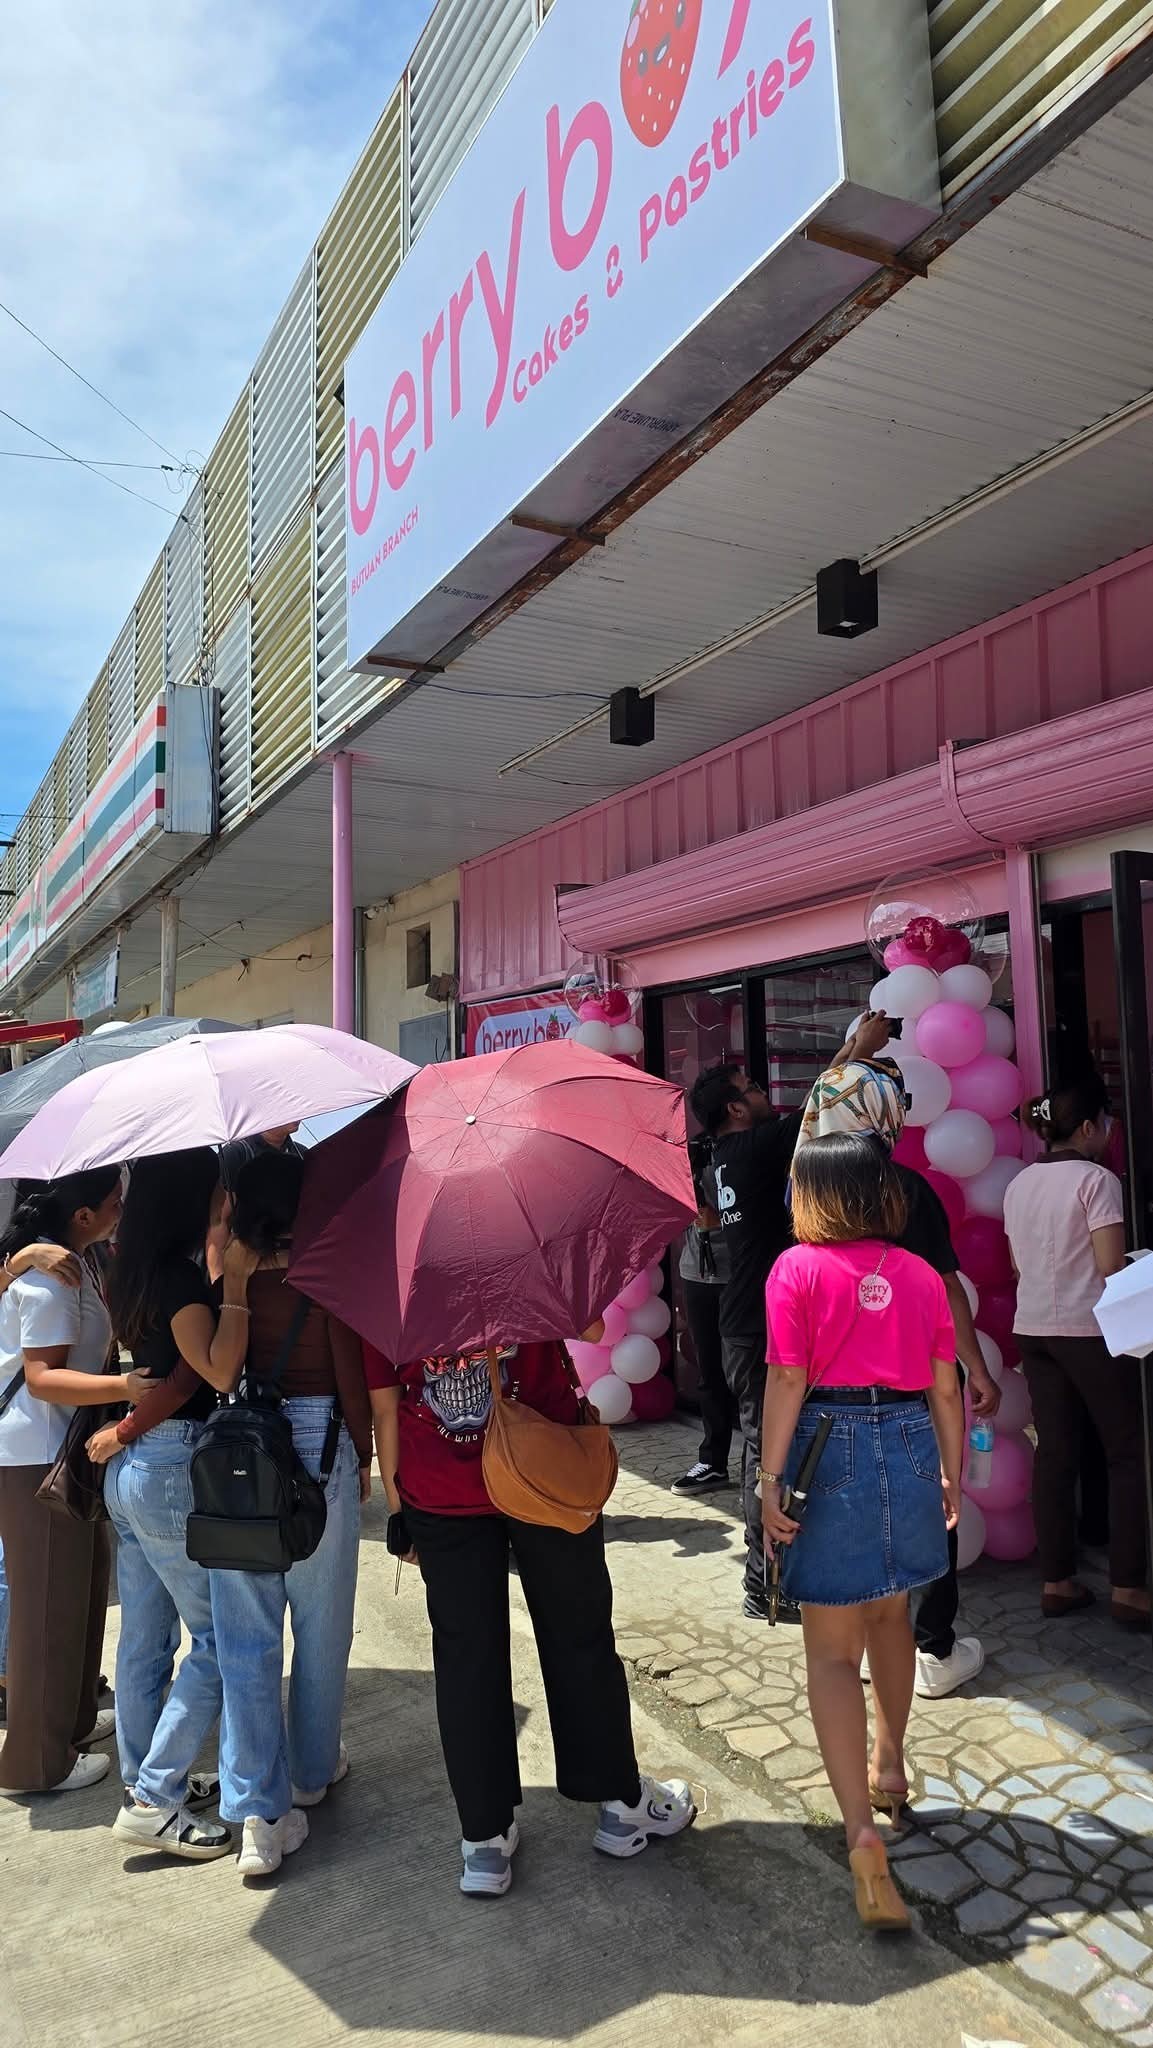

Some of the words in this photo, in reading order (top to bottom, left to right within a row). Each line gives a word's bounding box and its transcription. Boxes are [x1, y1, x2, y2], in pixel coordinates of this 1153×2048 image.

[349, 187, 526, 535] berry
[351, 549, 381, 597] BUTUAN
[382, 504, 419, 561] BRANCH
[482, 1023, 530, 1054] berry
[860, 1282, 888, 1295] berry
